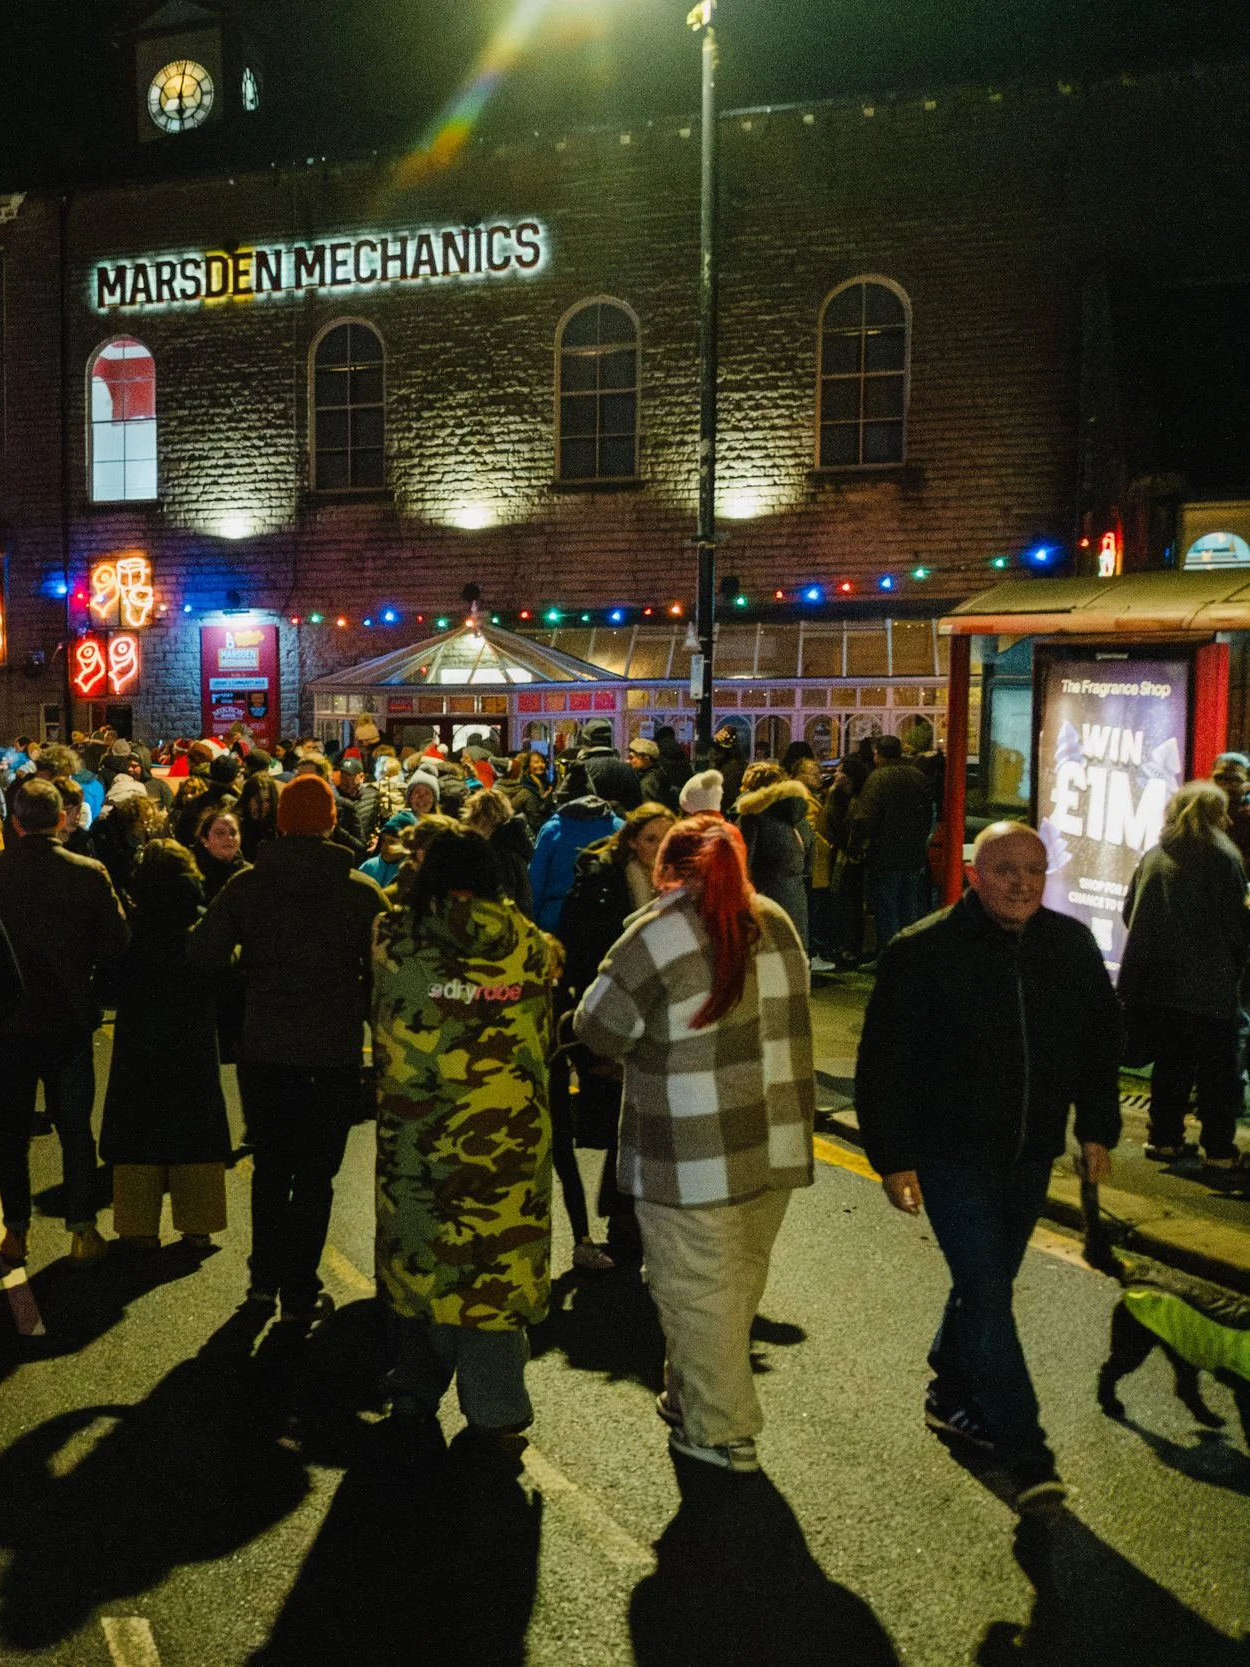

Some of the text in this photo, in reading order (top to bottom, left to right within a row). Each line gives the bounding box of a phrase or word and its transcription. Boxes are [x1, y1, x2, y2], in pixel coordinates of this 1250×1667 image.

[96, 222, 541, 309] MARSDEN MECHANICS
[1061, 679, 1171, 699] The Fragrance Shop
[1082, 722, 1144, 766] WIN
[1049, 760, 1167, 853] £1M
